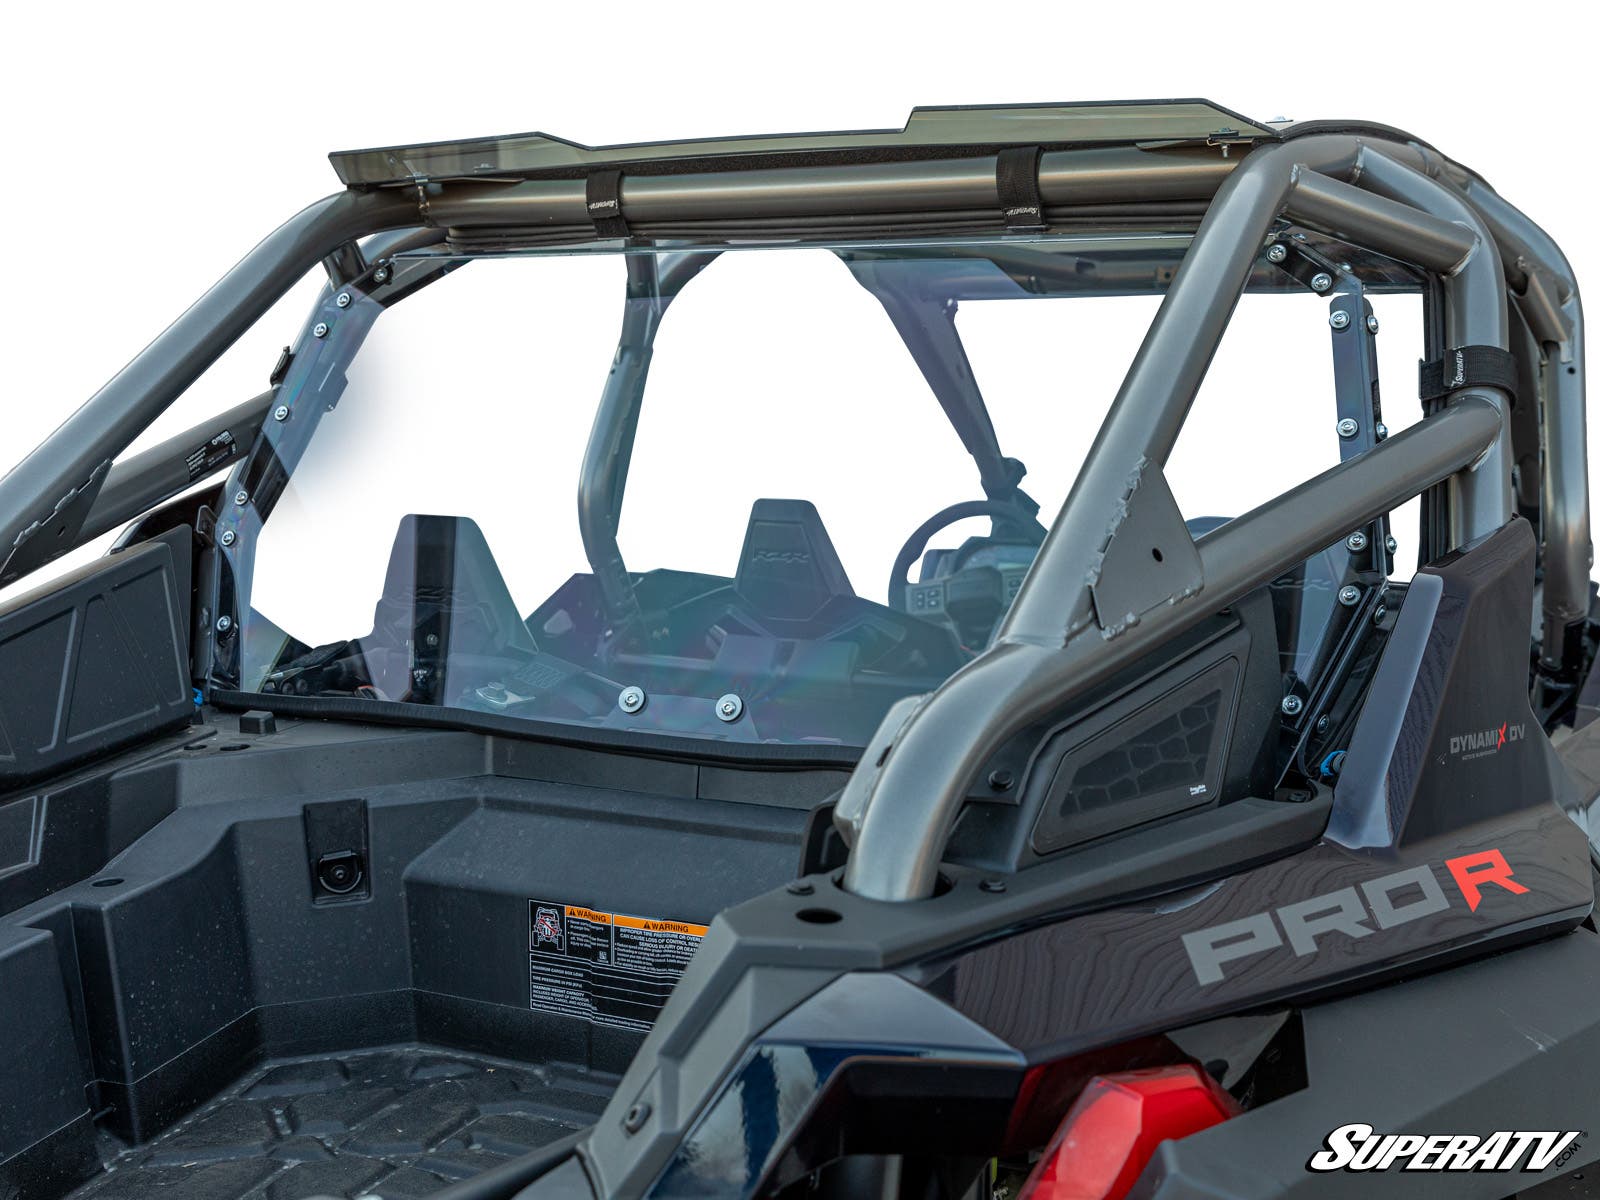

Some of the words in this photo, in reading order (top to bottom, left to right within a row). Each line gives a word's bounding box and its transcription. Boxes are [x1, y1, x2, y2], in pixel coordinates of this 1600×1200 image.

[1450, 720, 1507, 754] DYNAMIX
[1509, 723, 1525, 741] DV
[652, 922, 689, 933] WARNING
[1181, 864, 1450, 986] PRO
[1445, 849, 1530, 913] R
